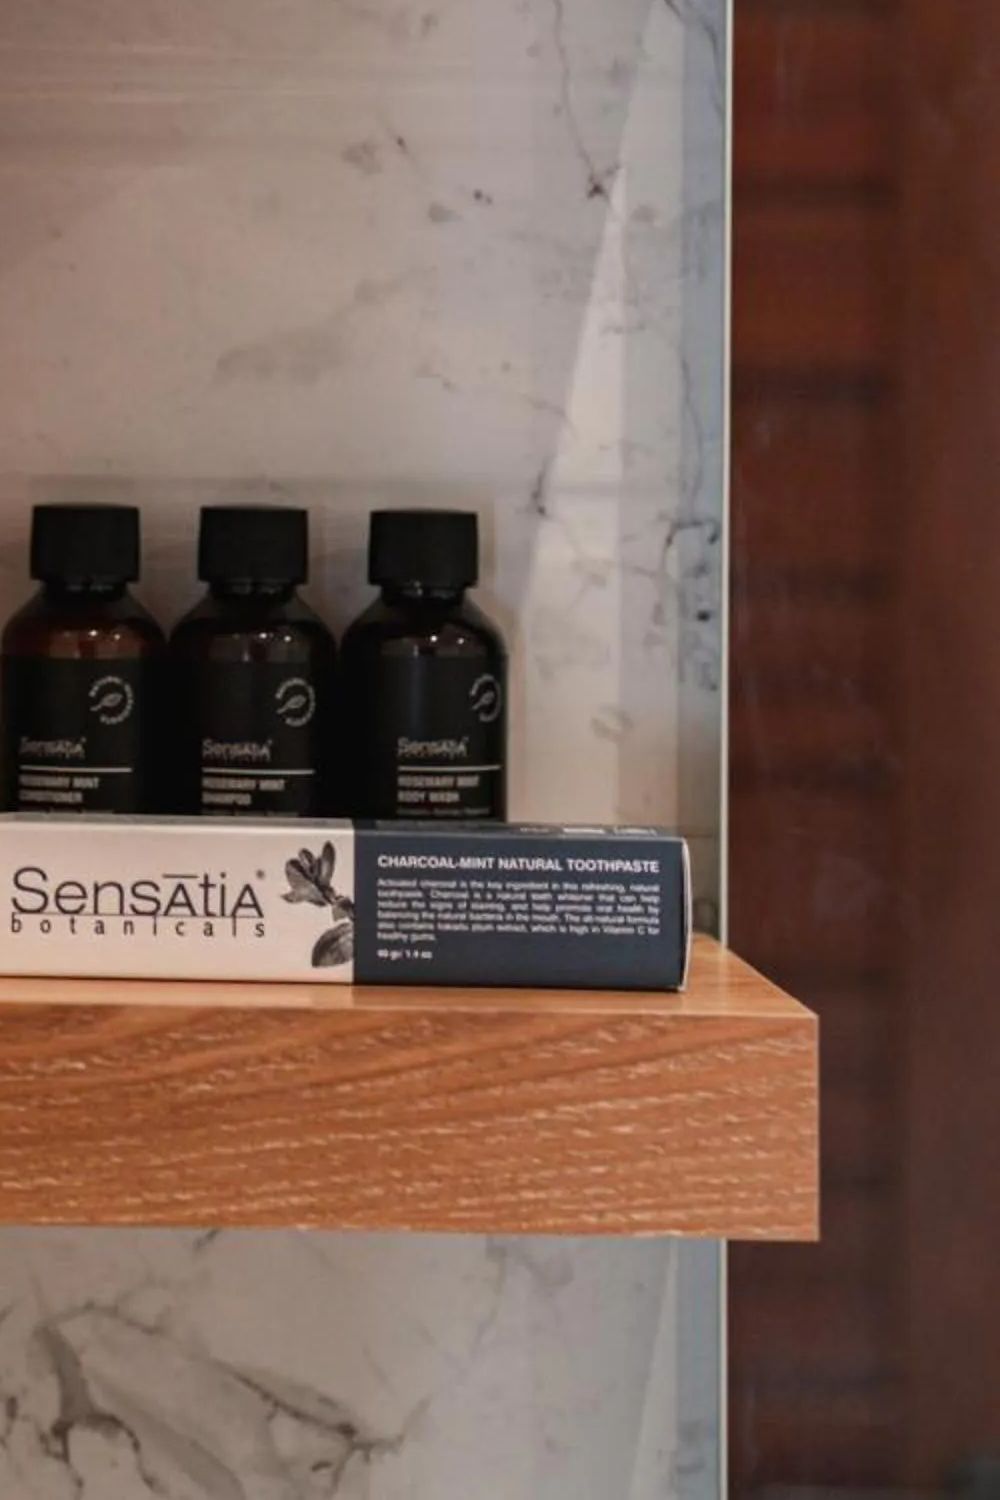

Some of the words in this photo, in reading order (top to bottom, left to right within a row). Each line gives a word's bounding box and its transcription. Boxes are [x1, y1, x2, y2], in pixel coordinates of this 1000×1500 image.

[377, 855, 495, 870] CHARCOAL-MINT
[498, 857, 562, 871] NATURAL
[566, 858, 660, 873] TOOTHPASTE
[11, 911, 265, 937] botanicals
